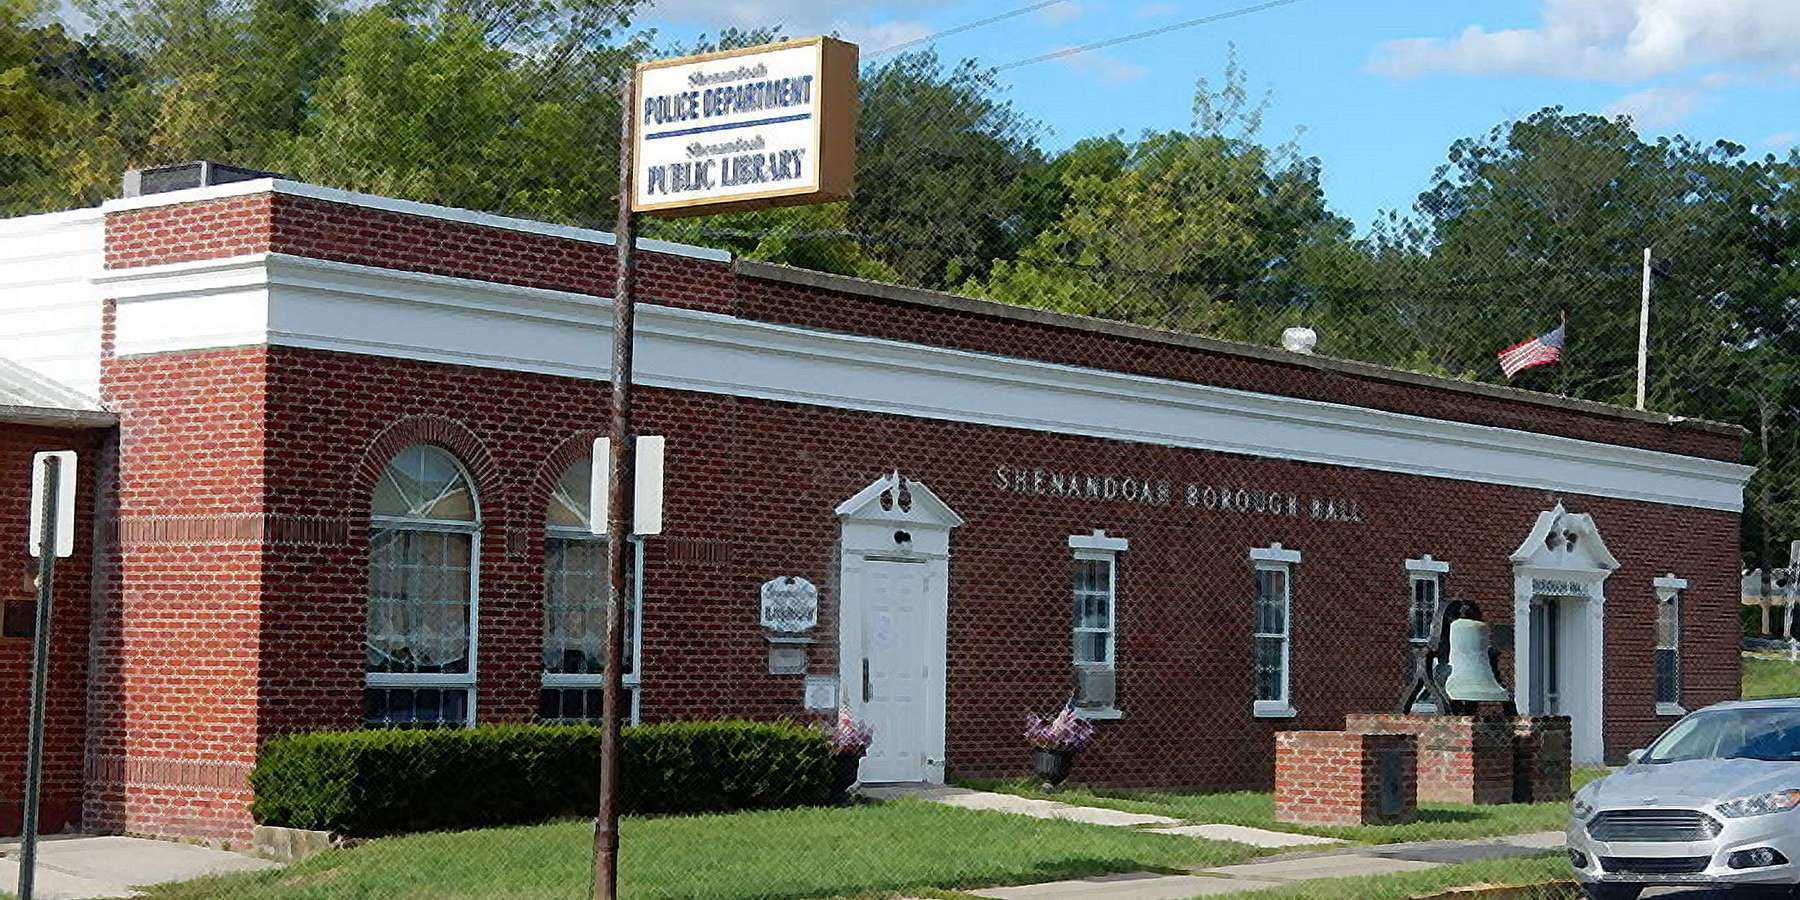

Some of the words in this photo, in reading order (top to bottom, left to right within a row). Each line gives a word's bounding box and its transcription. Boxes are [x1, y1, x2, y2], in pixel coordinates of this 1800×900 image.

[644, 92, 699, 126] POLICE
[703, 75, 813, 117] DEPARTMENT
[647, 160, 716, 195] PUBLIC
[721, 148, 806, 187] LIBRARY
[993, 464, 1171, 505] SHENANDOAH
[1186, 483, 1298, 518] BOROUGH
